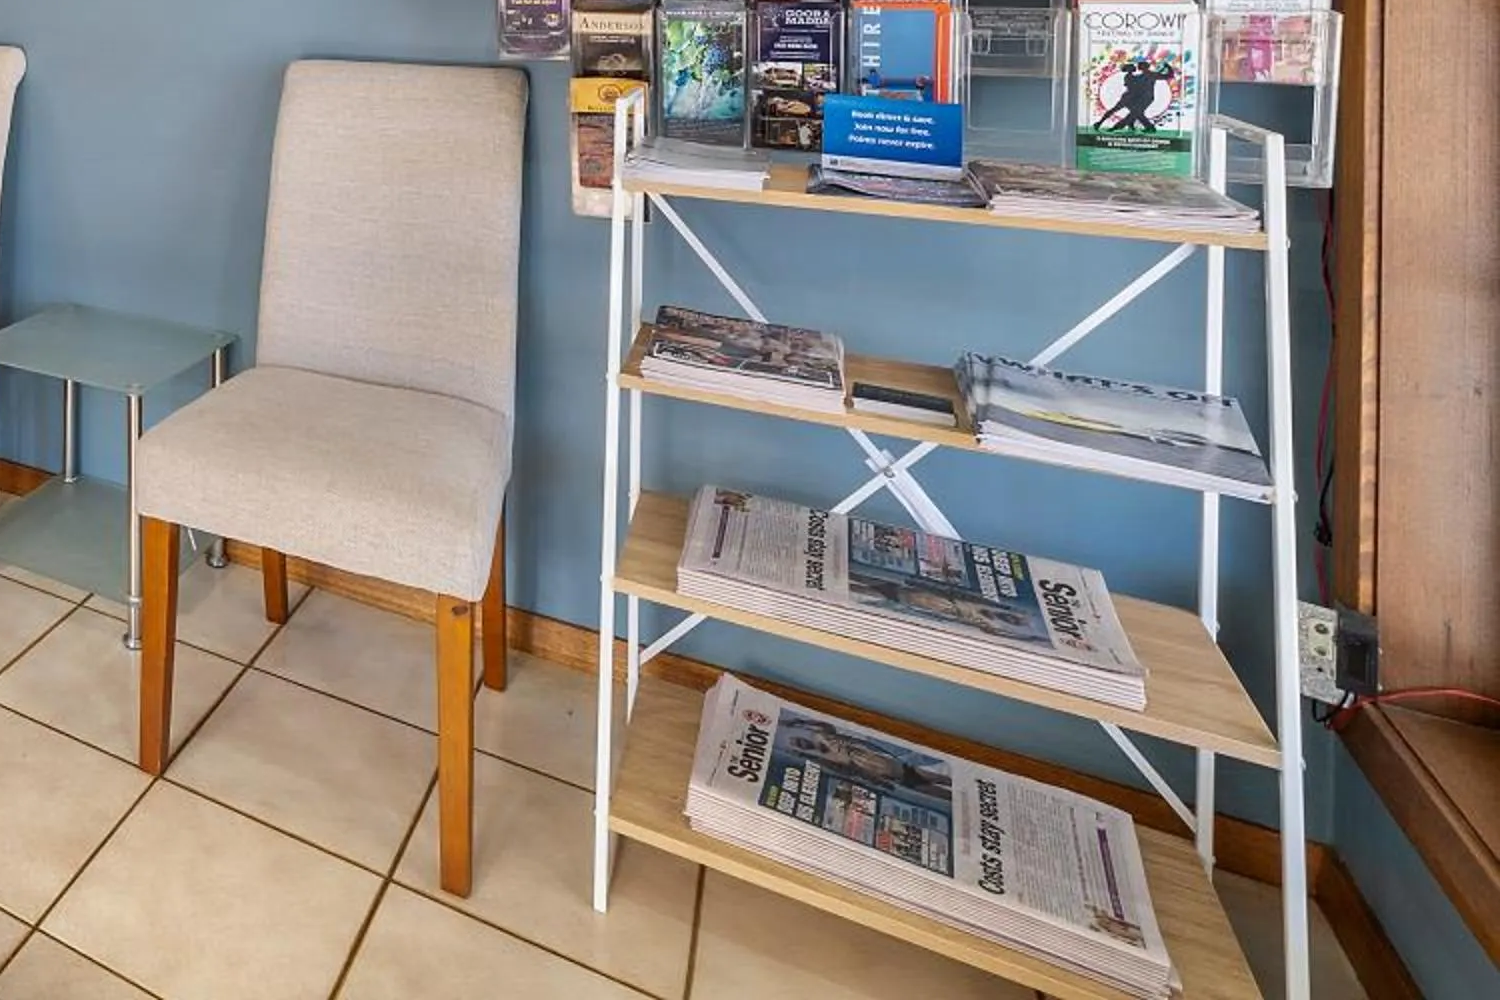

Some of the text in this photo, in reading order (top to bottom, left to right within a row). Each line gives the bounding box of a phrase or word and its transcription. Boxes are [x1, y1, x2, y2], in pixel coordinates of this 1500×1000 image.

[863, 6, 881, 67] HIRE
[874, 124, 895, 133] now
[1039, 579, 1086, 640] Senior
[727, 724, 769, 783] Senior
[975, 778, 1006, 895] Costs stay secret
